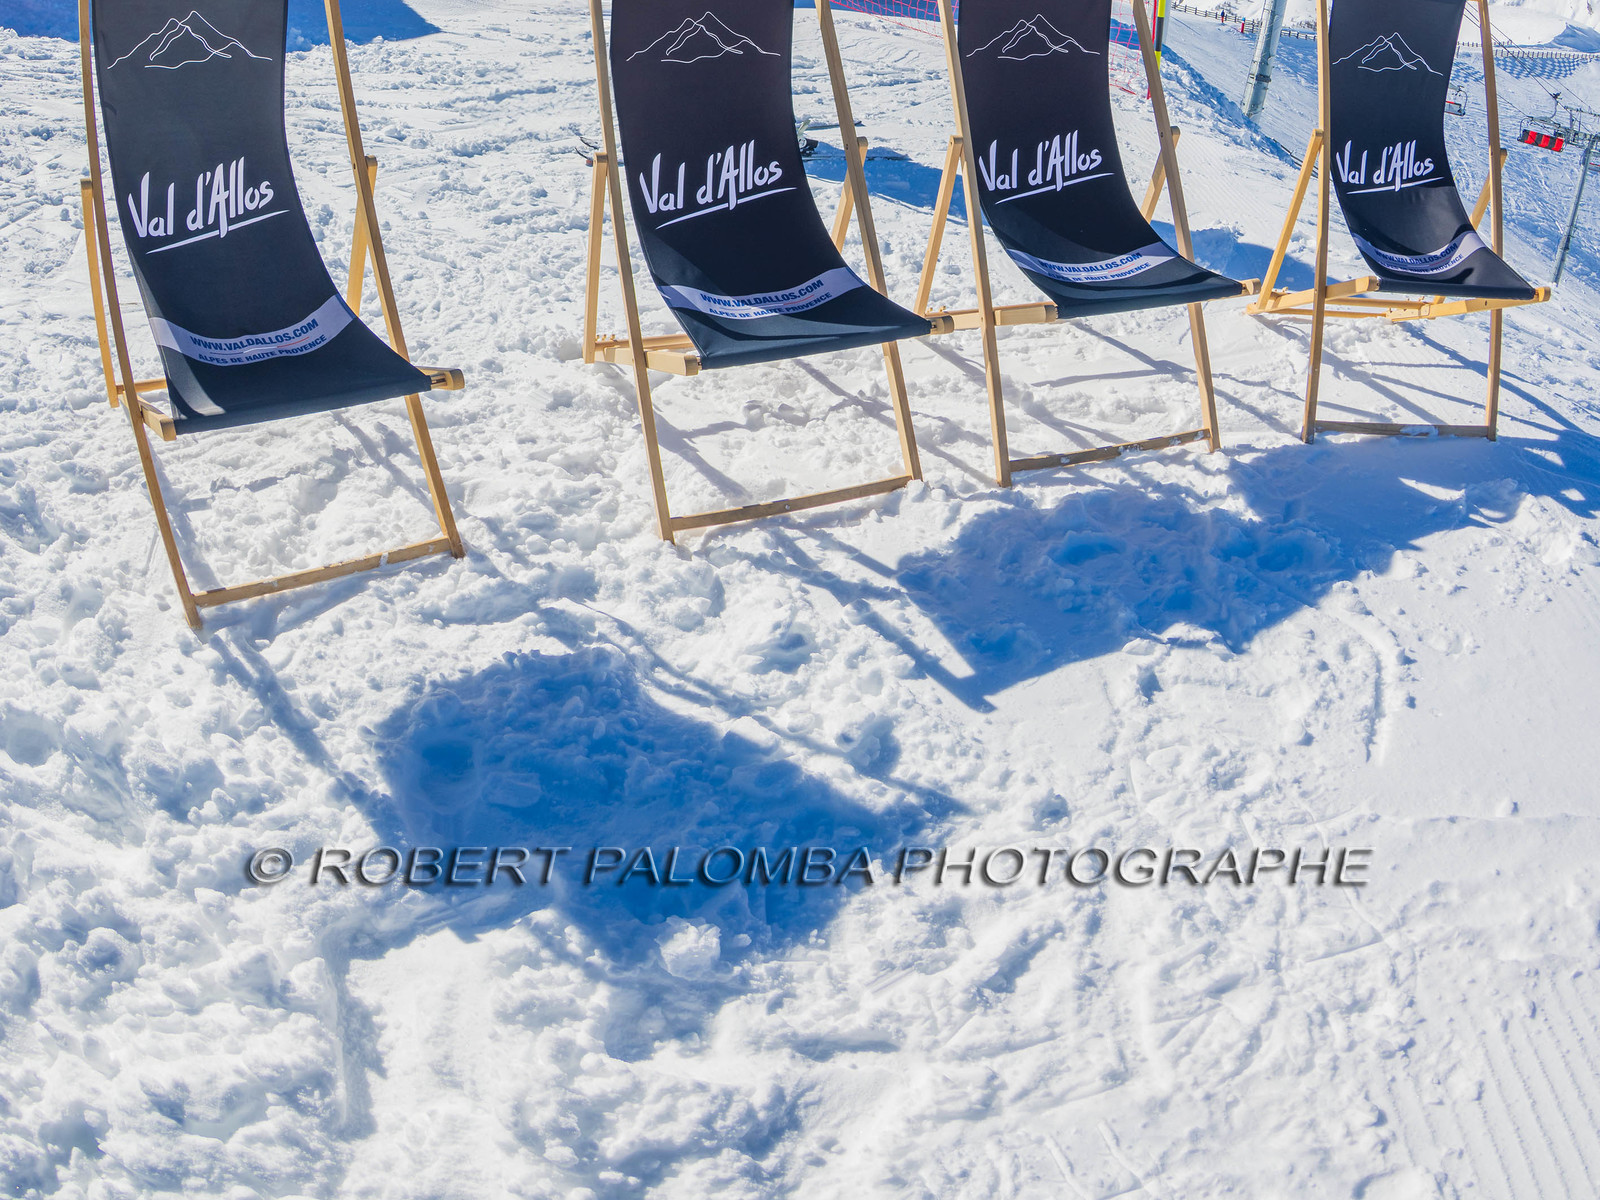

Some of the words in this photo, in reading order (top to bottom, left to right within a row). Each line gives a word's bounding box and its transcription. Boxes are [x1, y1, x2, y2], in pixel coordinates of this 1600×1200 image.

[639, 152, 686, 214] Val
[696, 139, 783, 211] d'Allos
[978, 139, 1019, 192] Val
[1027, 129, 1103, 192] d'Allos
[1335, 139, 1368, 185] Val
[1372, 139, 1435, 192] d'Allos
[127, 171, 175, 238] Val
[186, 156, 274, 239] d'Allos
[1037, 252, 1143, 274] WWW.VALDALLOS.COM
[1084, 274, 1110, 282] HAUTE
[1111, 261, 1152, 279] PROVENCE
[699, 278, 825, 308] WWW.VALDALLOS.COM
[708, 307, 738, 318] ALPES
[753, 307, 784, 317] HAUTE
[785, 292, 832, 314] PROVENCE
[190, 318, 319, 352] WWW.VALDALLOS.COM
[198, 353, 228, 365] ALPES
[246, 350, 277, 362] HAUTE
[279, 334, 327, 355] PROVENCE
